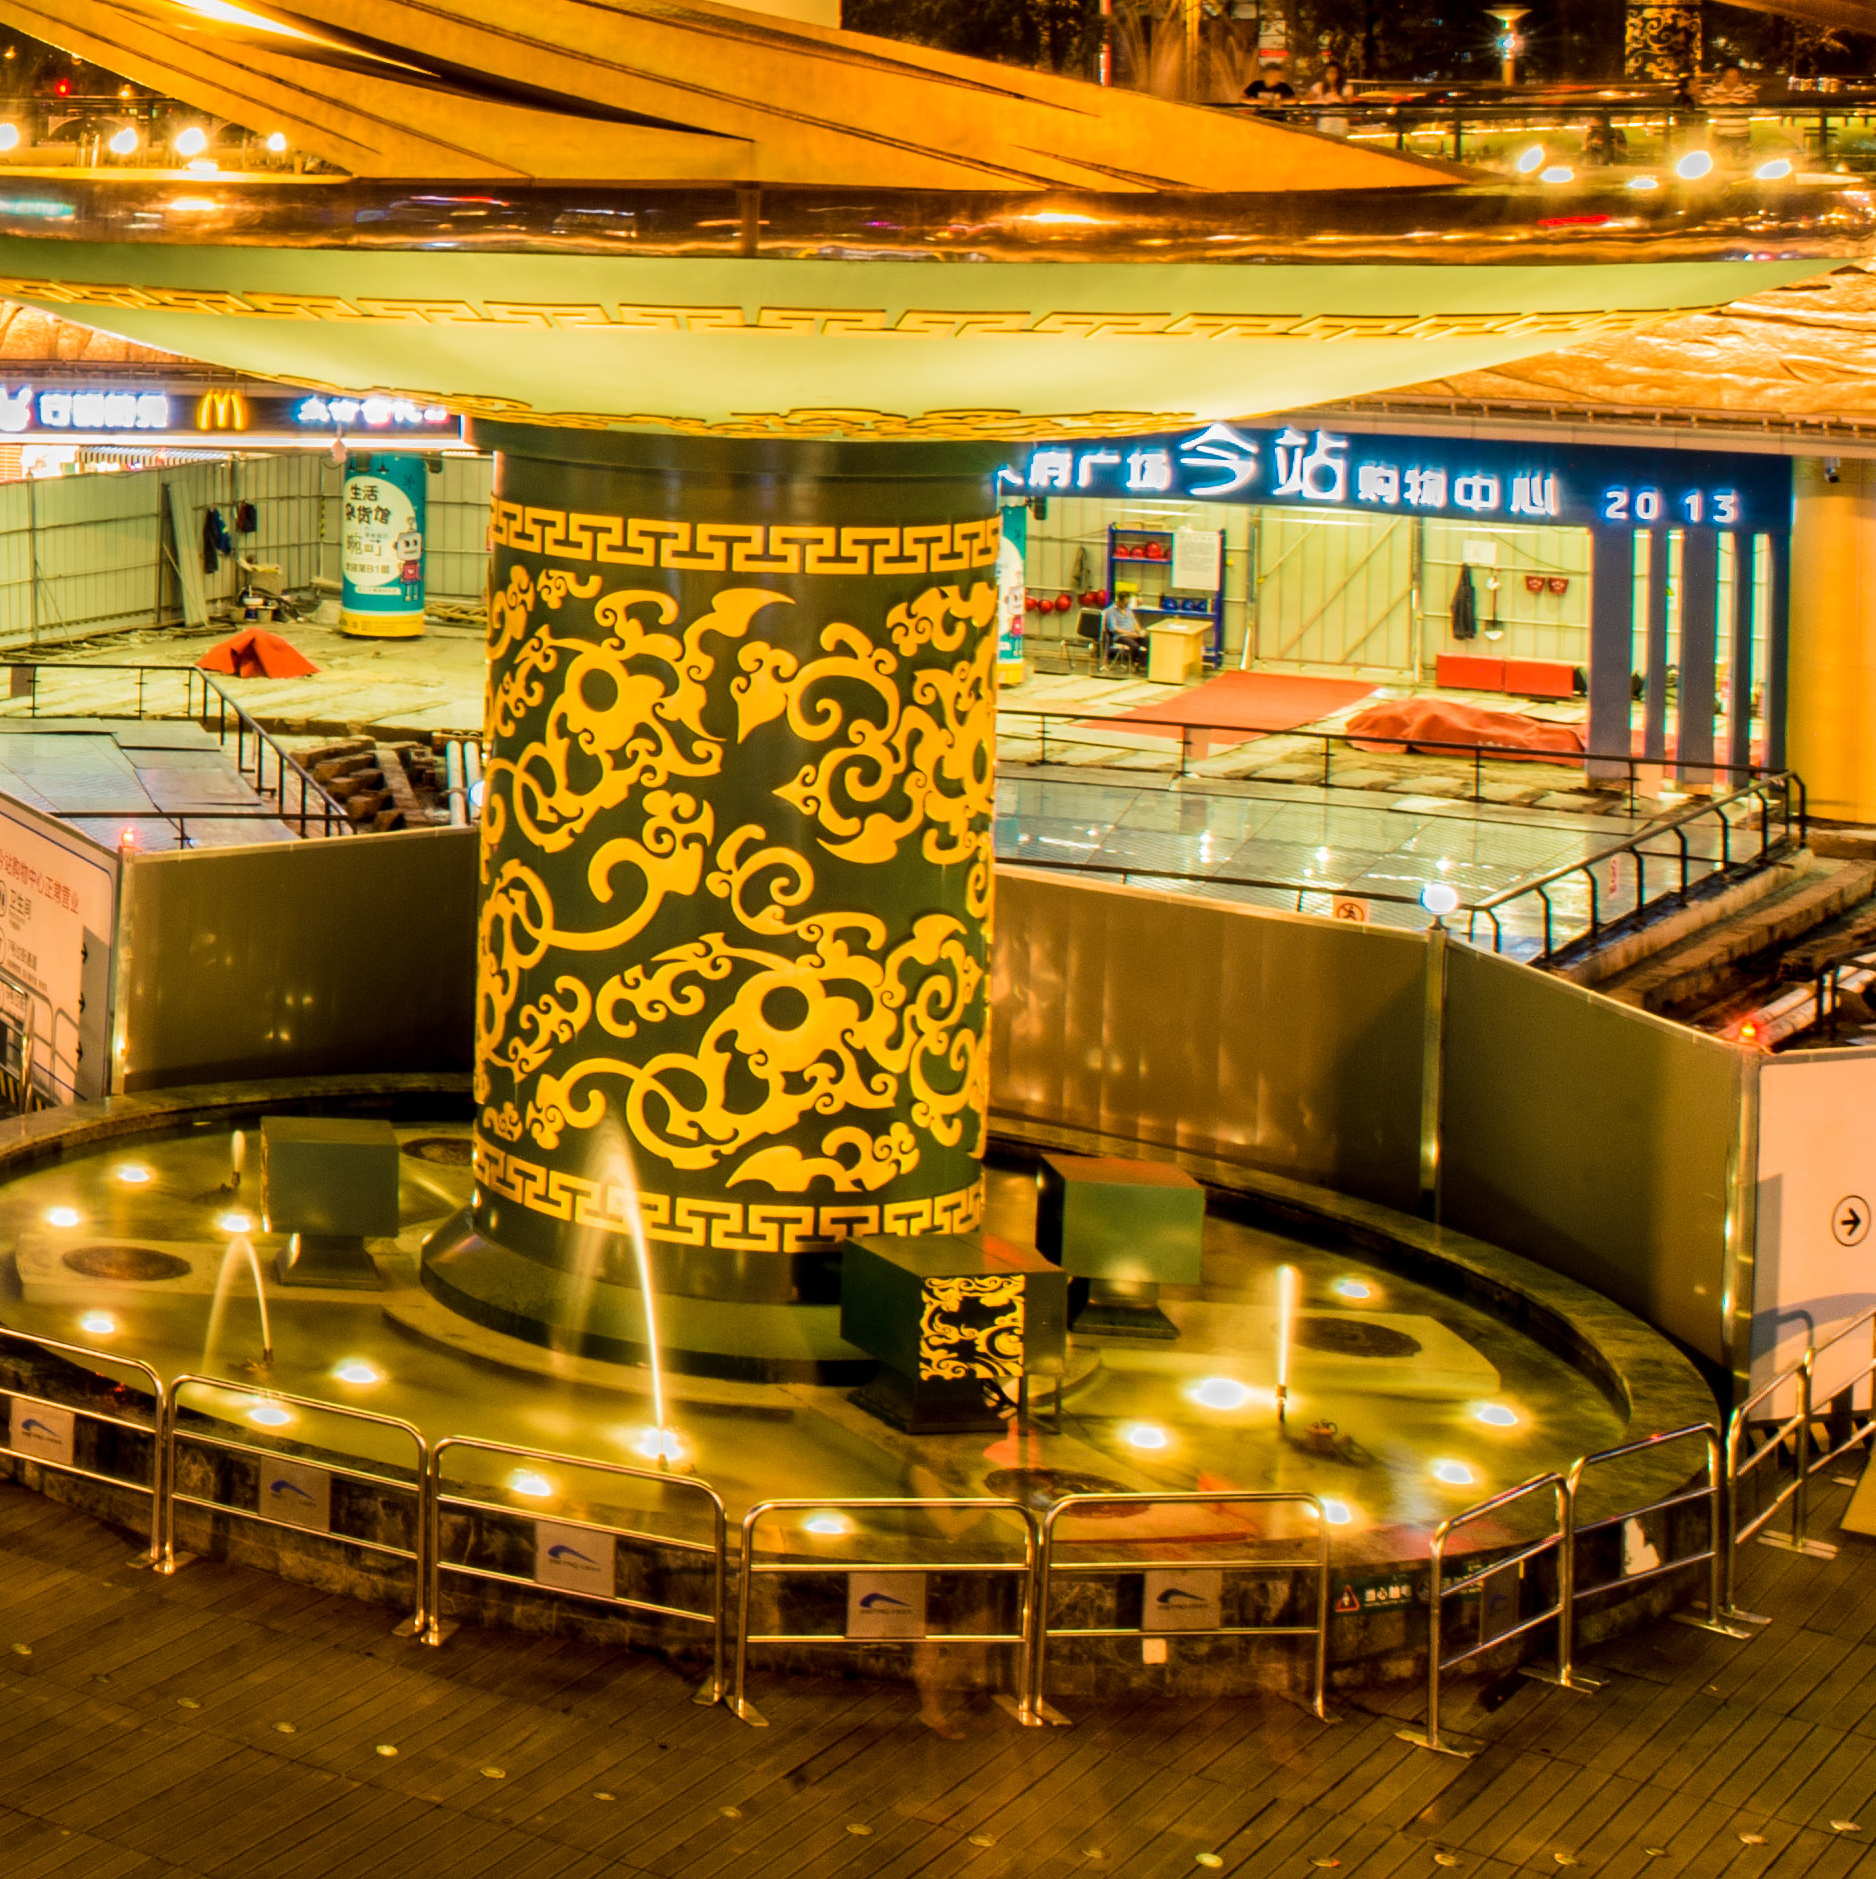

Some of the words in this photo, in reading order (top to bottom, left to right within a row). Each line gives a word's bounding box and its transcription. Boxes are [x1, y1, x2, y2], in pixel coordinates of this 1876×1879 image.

[350, 484, 379, 502] 生活
[998, 421, 1558, 516] 府广场今站购物中心
